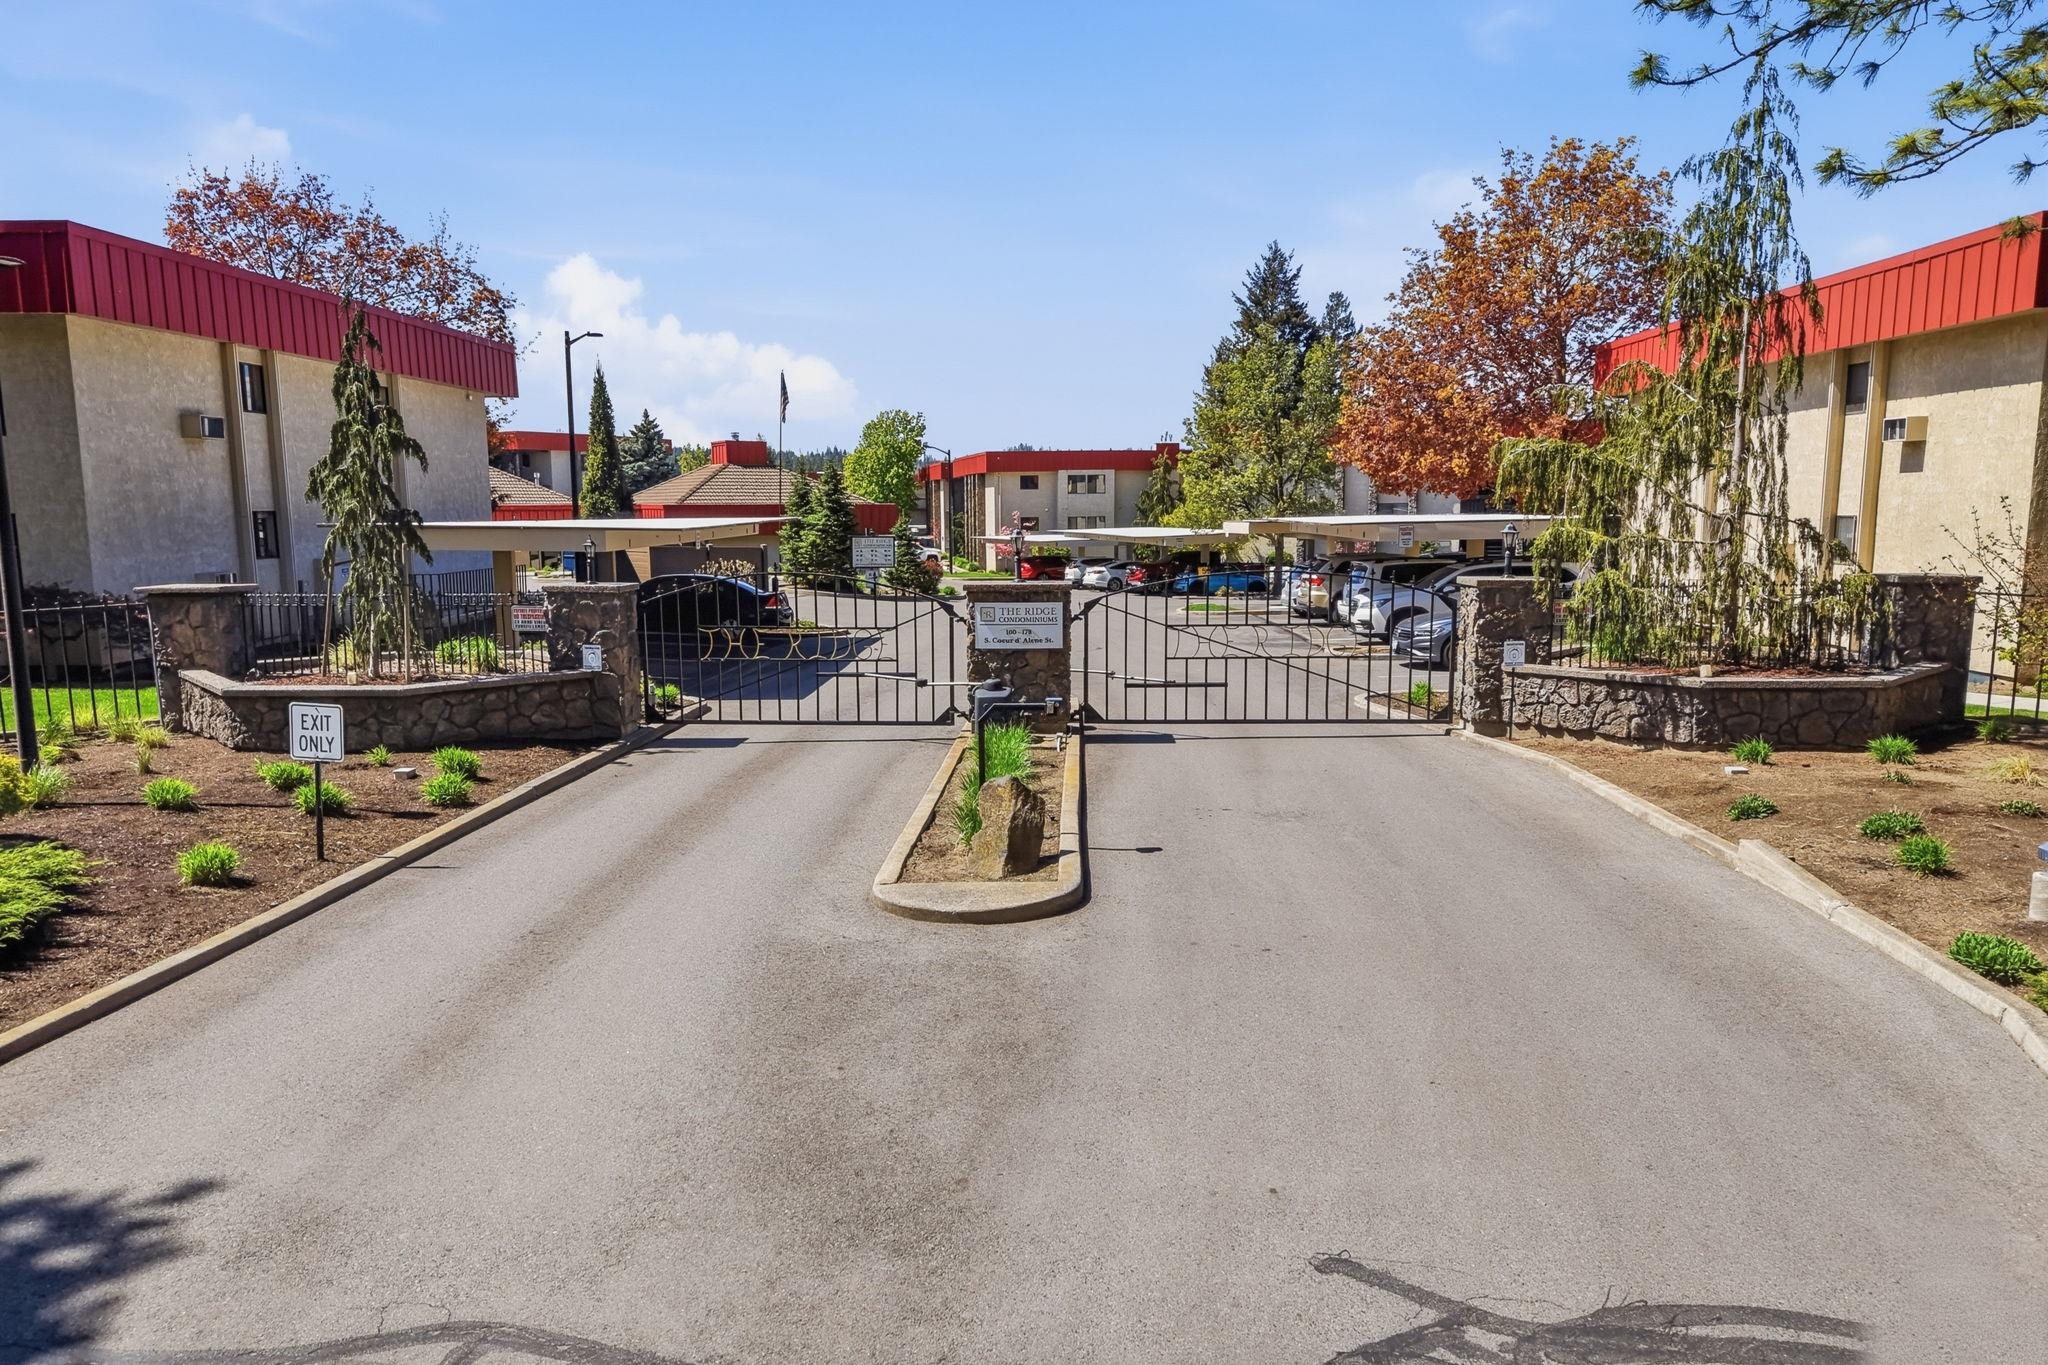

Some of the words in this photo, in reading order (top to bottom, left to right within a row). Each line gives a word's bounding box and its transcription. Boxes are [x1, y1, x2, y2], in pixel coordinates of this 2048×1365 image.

[999, 607, 1021, 615] THE
[1024, 607, 1057, 615] RIDGE
[301, 713, 332, 732] EXIT
[299, 734, 335, 754] ONLY
